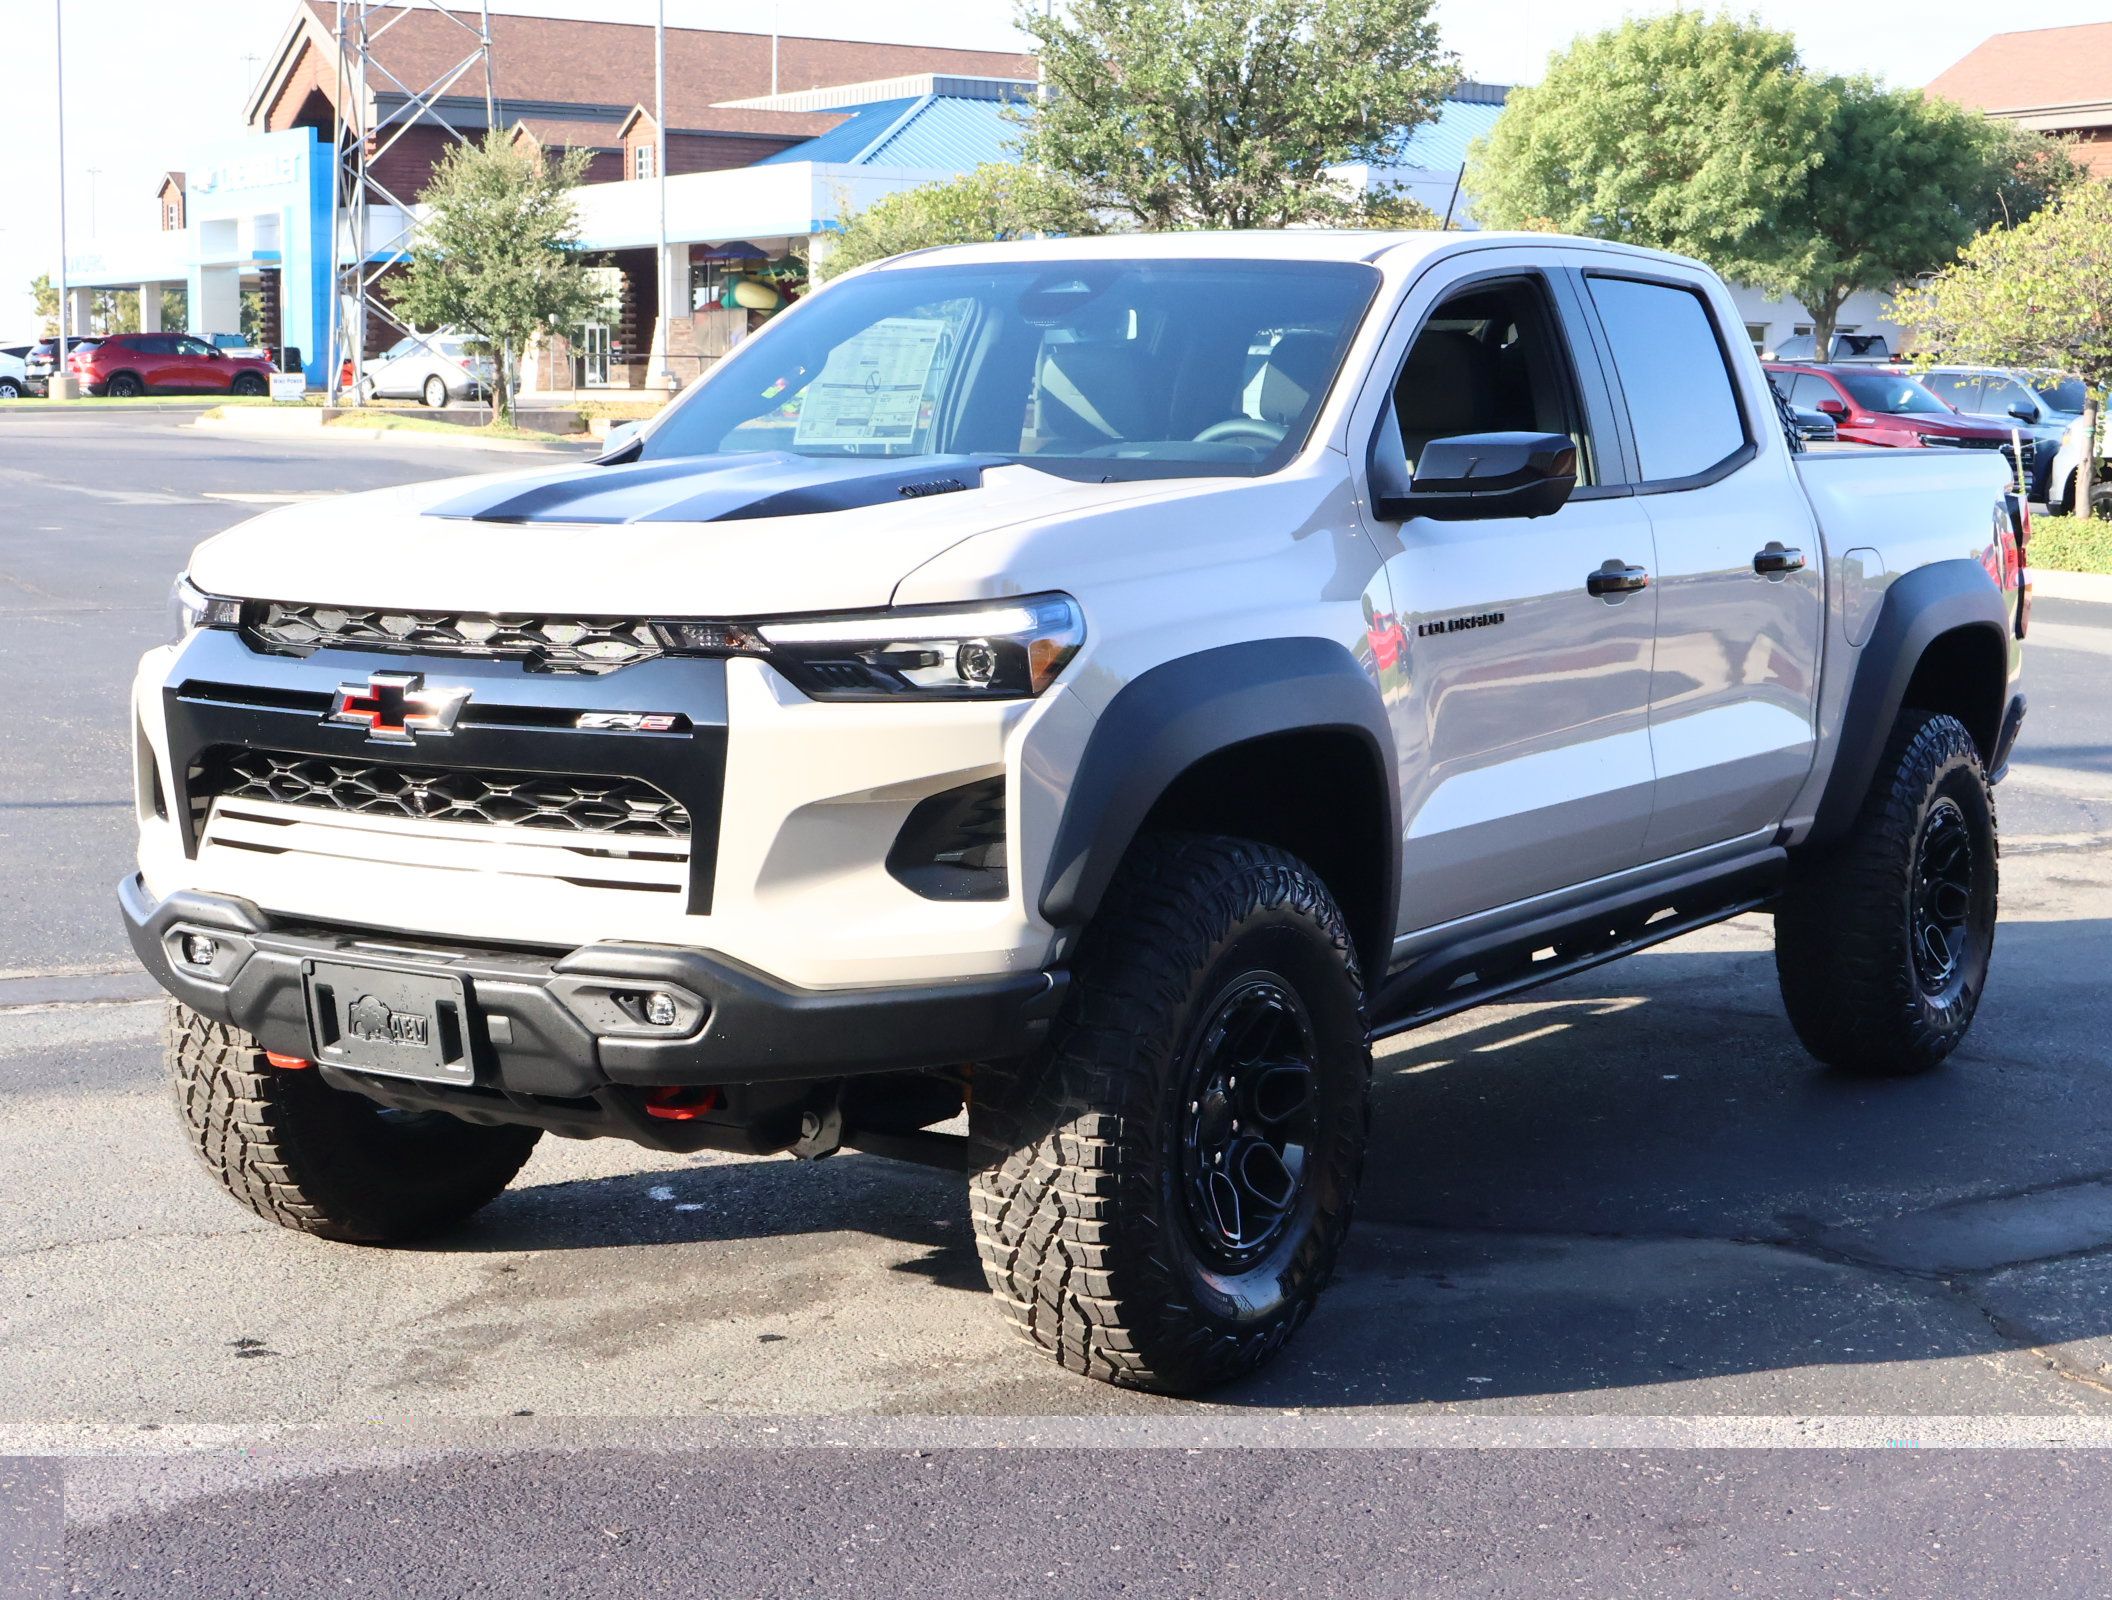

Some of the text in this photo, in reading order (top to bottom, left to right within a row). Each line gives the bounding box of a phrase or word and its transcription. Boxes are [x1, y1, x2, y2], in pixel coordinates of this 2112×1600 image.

[1418, 612, 1505, 637] COLORADO
[576, 712, 676, 731] ZR2
[391, 1012, 426, 1042] AEV
